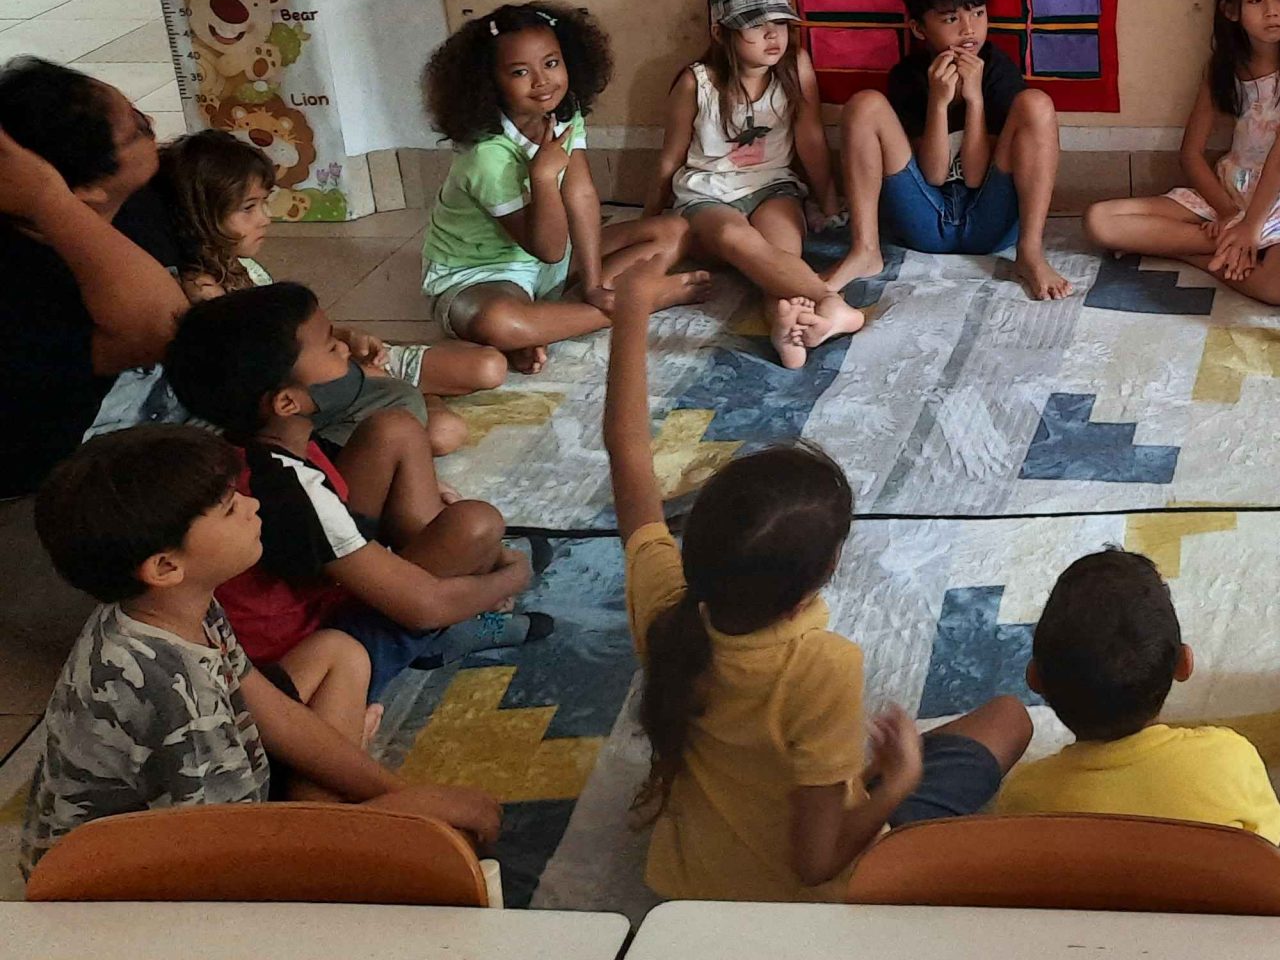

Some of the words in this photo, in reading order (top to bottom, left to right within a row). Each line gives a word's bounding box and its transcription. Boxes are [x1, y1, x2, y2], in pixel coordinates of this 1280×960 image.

[179, 8, 193, 17] 50
[280, 8, 318, 21] Bear
[187, 51, 200, 60] 40
[190, 72, 204, 81] 35
[290, 92, 329, 106] Lion
